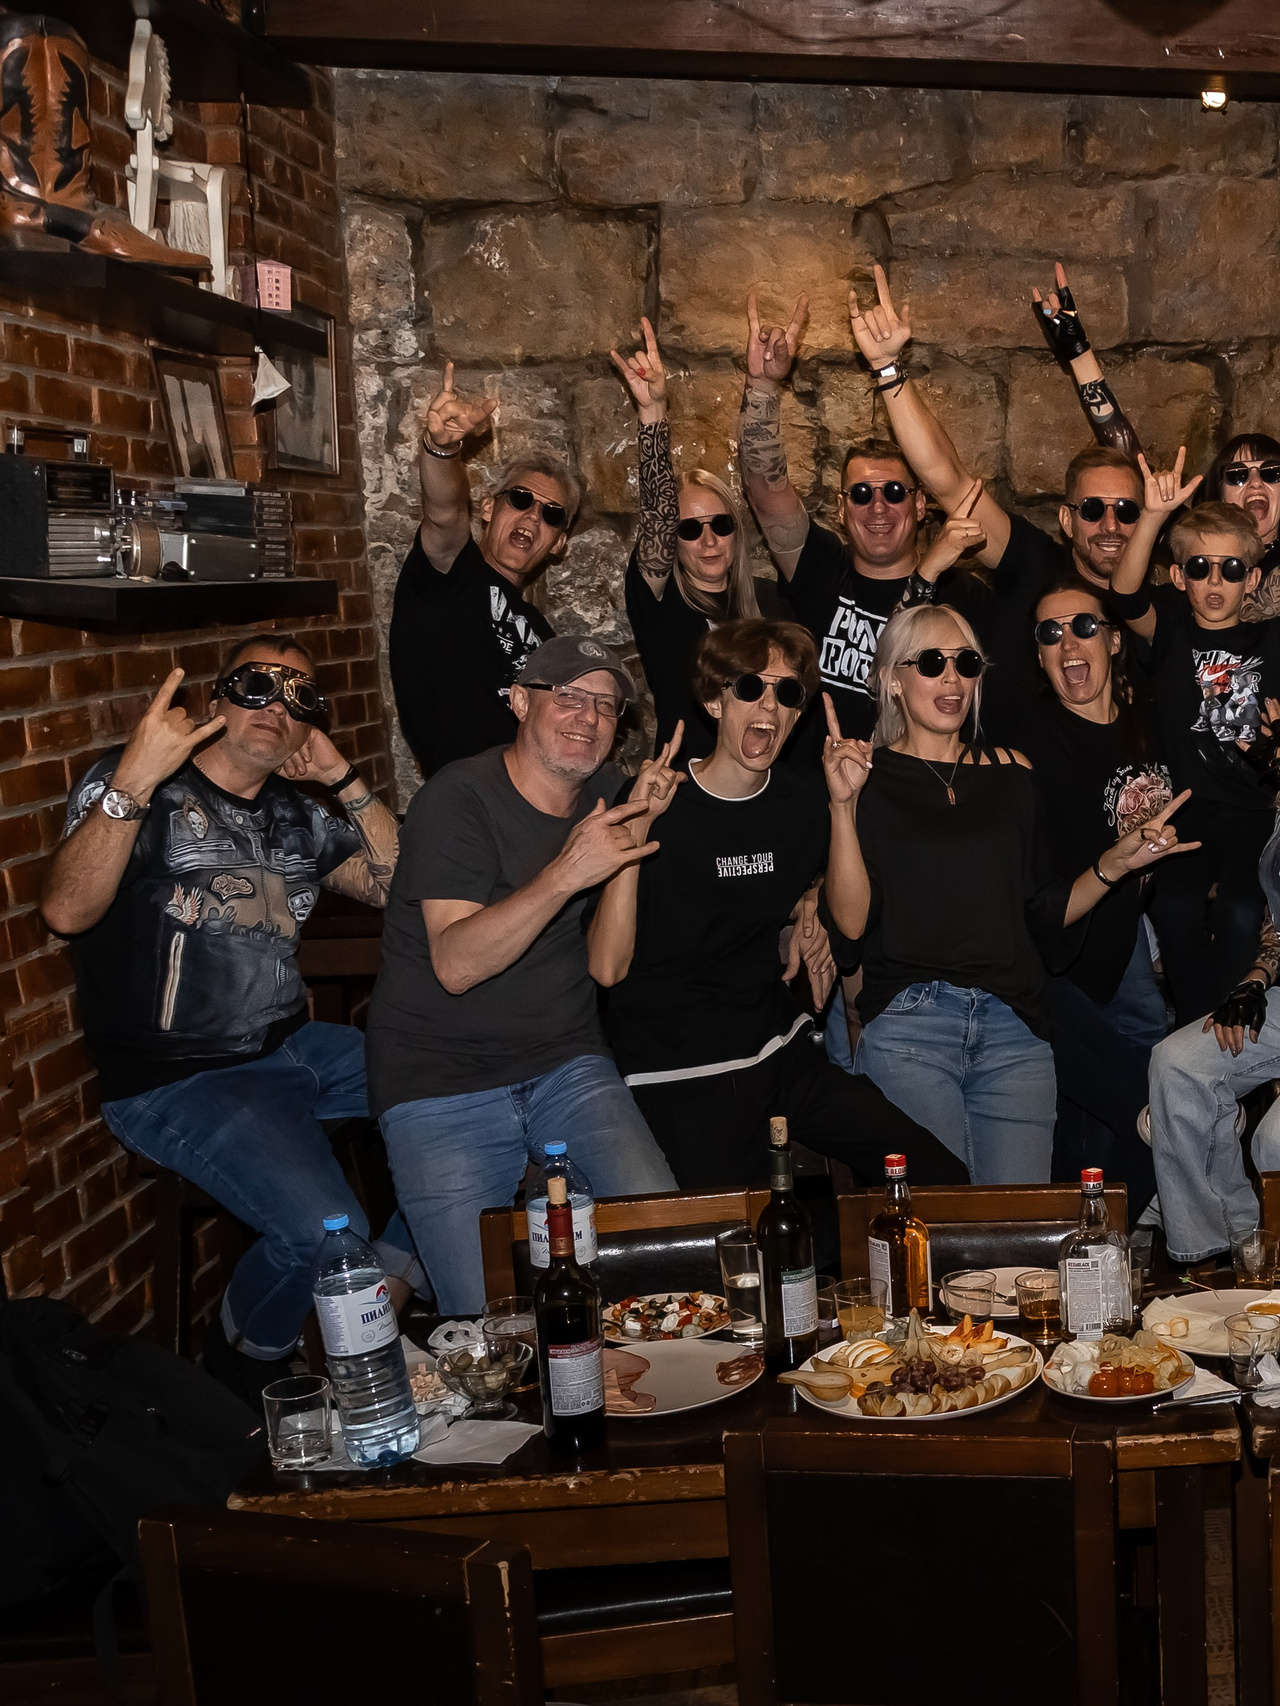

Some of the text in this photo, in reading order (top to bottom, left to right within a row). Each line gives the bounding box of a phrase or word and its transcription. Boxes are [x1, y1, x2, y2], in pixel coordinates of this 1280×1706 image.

[819, 637, 874, 688] ROC
[716, 852, 774, 867] CHANGE YOUR
[718, 862, 774, 877] PERSPECTIVE
